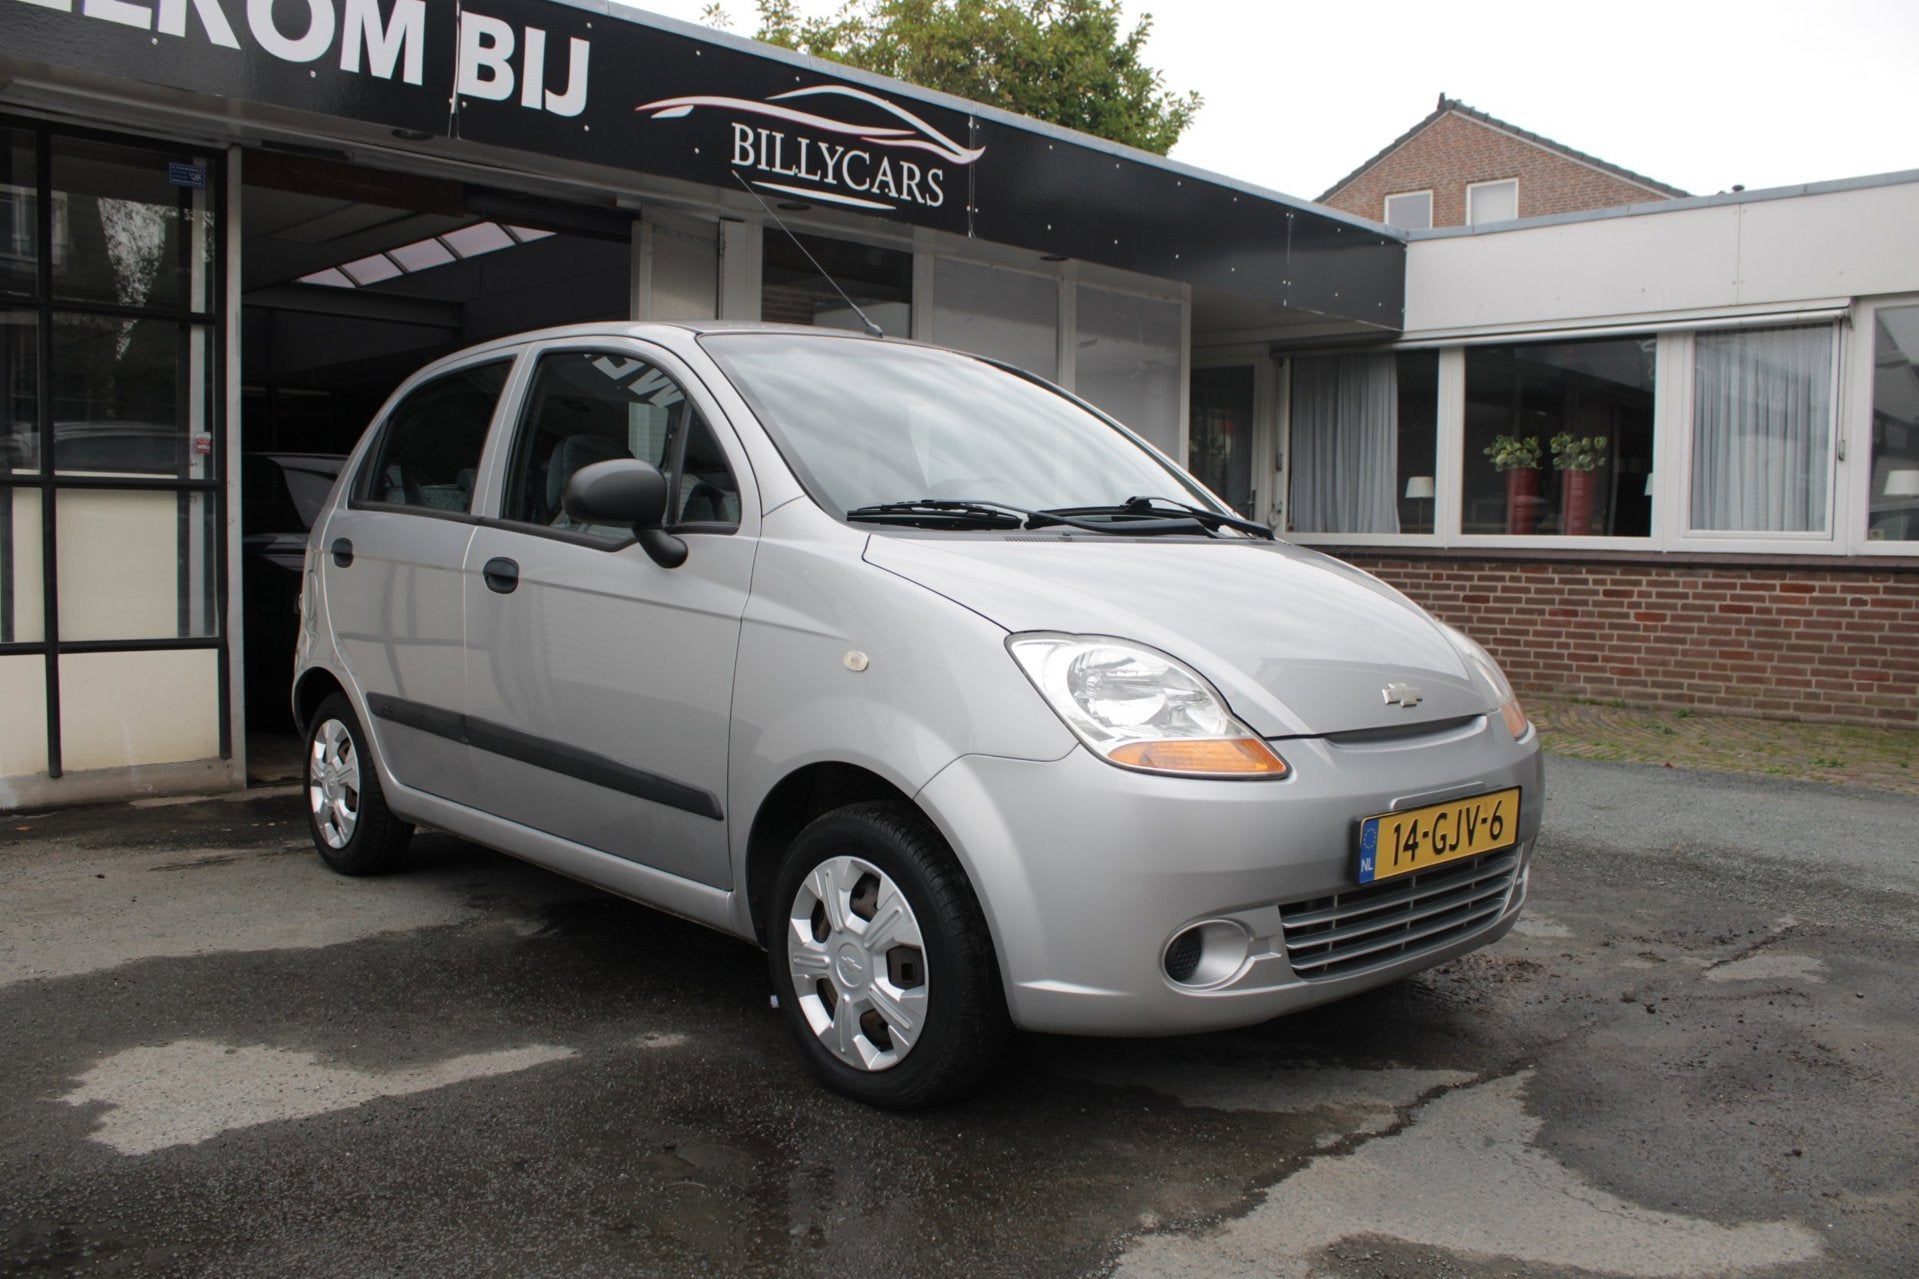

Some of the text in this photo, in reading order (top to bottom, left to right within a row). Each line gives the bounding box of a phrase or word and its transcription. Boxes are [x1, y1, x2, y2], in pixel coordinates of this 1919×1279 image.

[457, 10, 591, 117] BIJ
[731, 122, 945, 208] BILLYCARS
[1360, 857, 1374, 873] NL
[1393, 800, 1504, 867] 14-GJV-6
